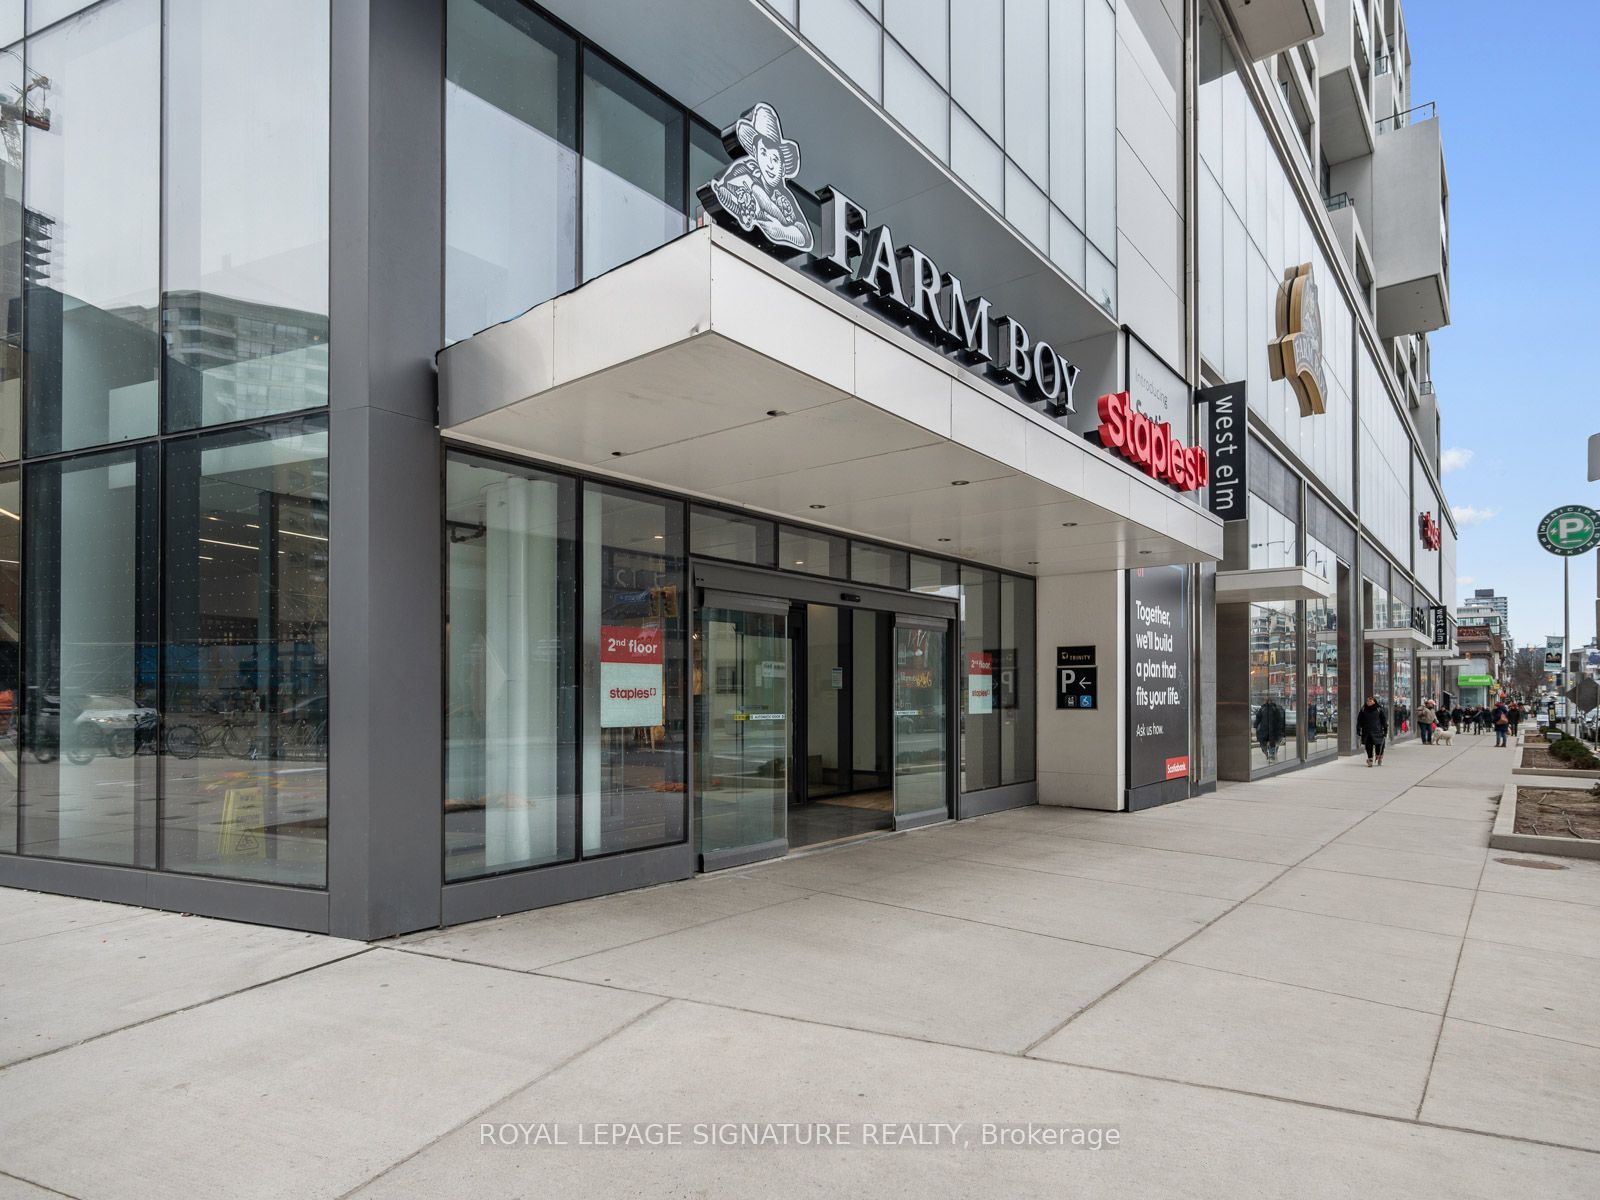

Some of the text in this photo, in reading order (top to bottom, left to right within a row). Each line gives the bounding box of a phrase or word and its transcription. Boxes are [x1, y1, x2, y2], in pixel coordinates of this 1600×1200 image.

[817, 184, 1081, 414] FARM BOY
[1215, 395, 1239, 511] west elm
[1540, 507, 1600, 532] MUNICIPAL
[1559, 518, 1585, 539] P
[1541, 533, 1600, 554] PARKING
[1135, 599, 1171, 628] Together,
[607, 638, 658, 654] 2nd floor
[1135, 630, 1173, 653] we'll build
[1136, 658, 1177, 681] a plan that
[1061, 670, 1076, 693] P
[609, 687, 650, 700] staples
[1136, 685, 1181, 710] fits your life.
[1136, 723, 1146, 737] Ask
[1146, 725, 1153, 736] us
